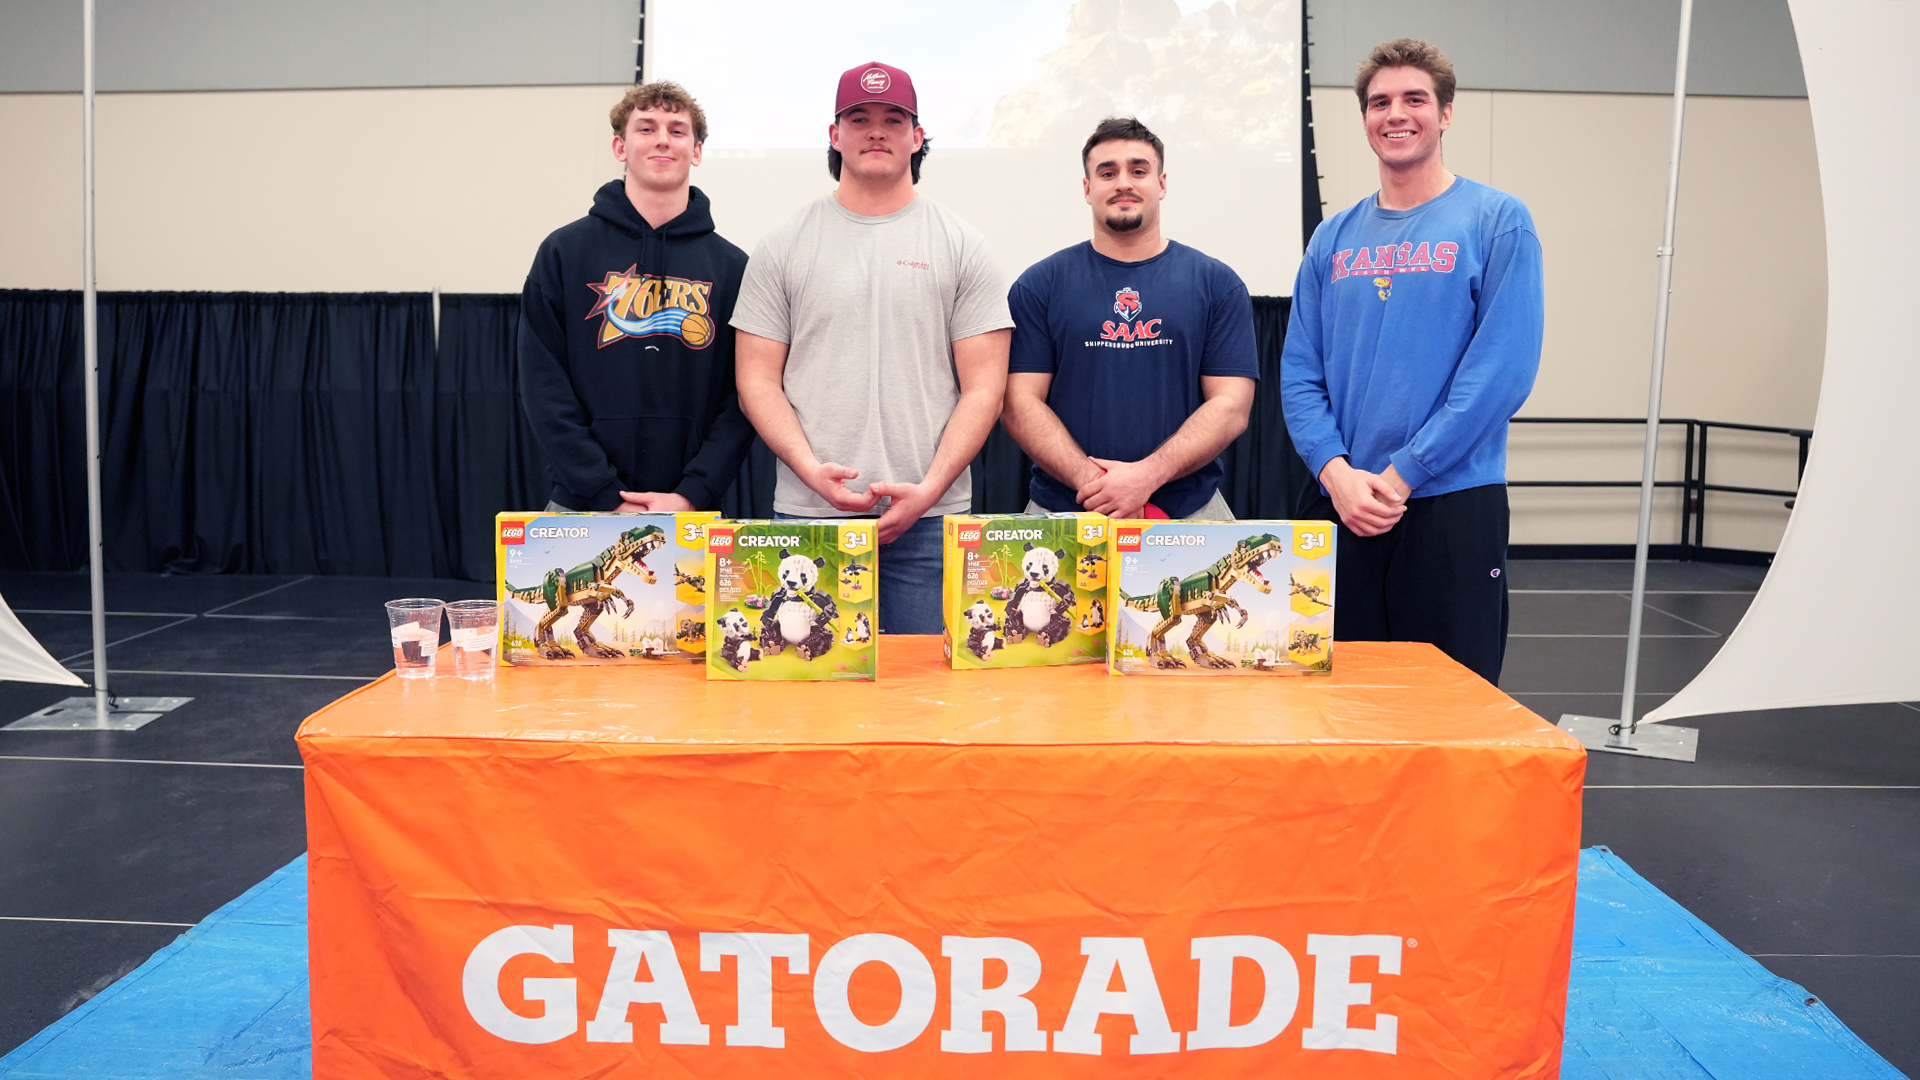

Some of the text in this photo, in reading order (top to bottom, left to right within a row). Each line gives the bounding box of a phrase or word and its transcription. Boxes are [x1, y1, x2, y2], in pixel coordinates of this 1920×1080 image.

[1332, 241, 1459, 283] KANSAS
[1100, 319, 1161, 341] SAAC
[1085, 339, 1173, 349] SHIPPENSBURG UNIVERSITY
[502, 527, 589, 538] LEGO CREATOR
[959, 529, 1042, 541] LEGO CREATOR
[710, 535, 800, 547] LEGO CREATOR
[1118, 535, 1206, 546] LEGO CREATOR
[509, 549, 523, 558] 9+
[967, 552, 979, 560] 8+
[719, 558, 732, 566] 8+
[1124, 556, 1138, 565] 9+
[462, 924, 1403, 1055] GATORADE
